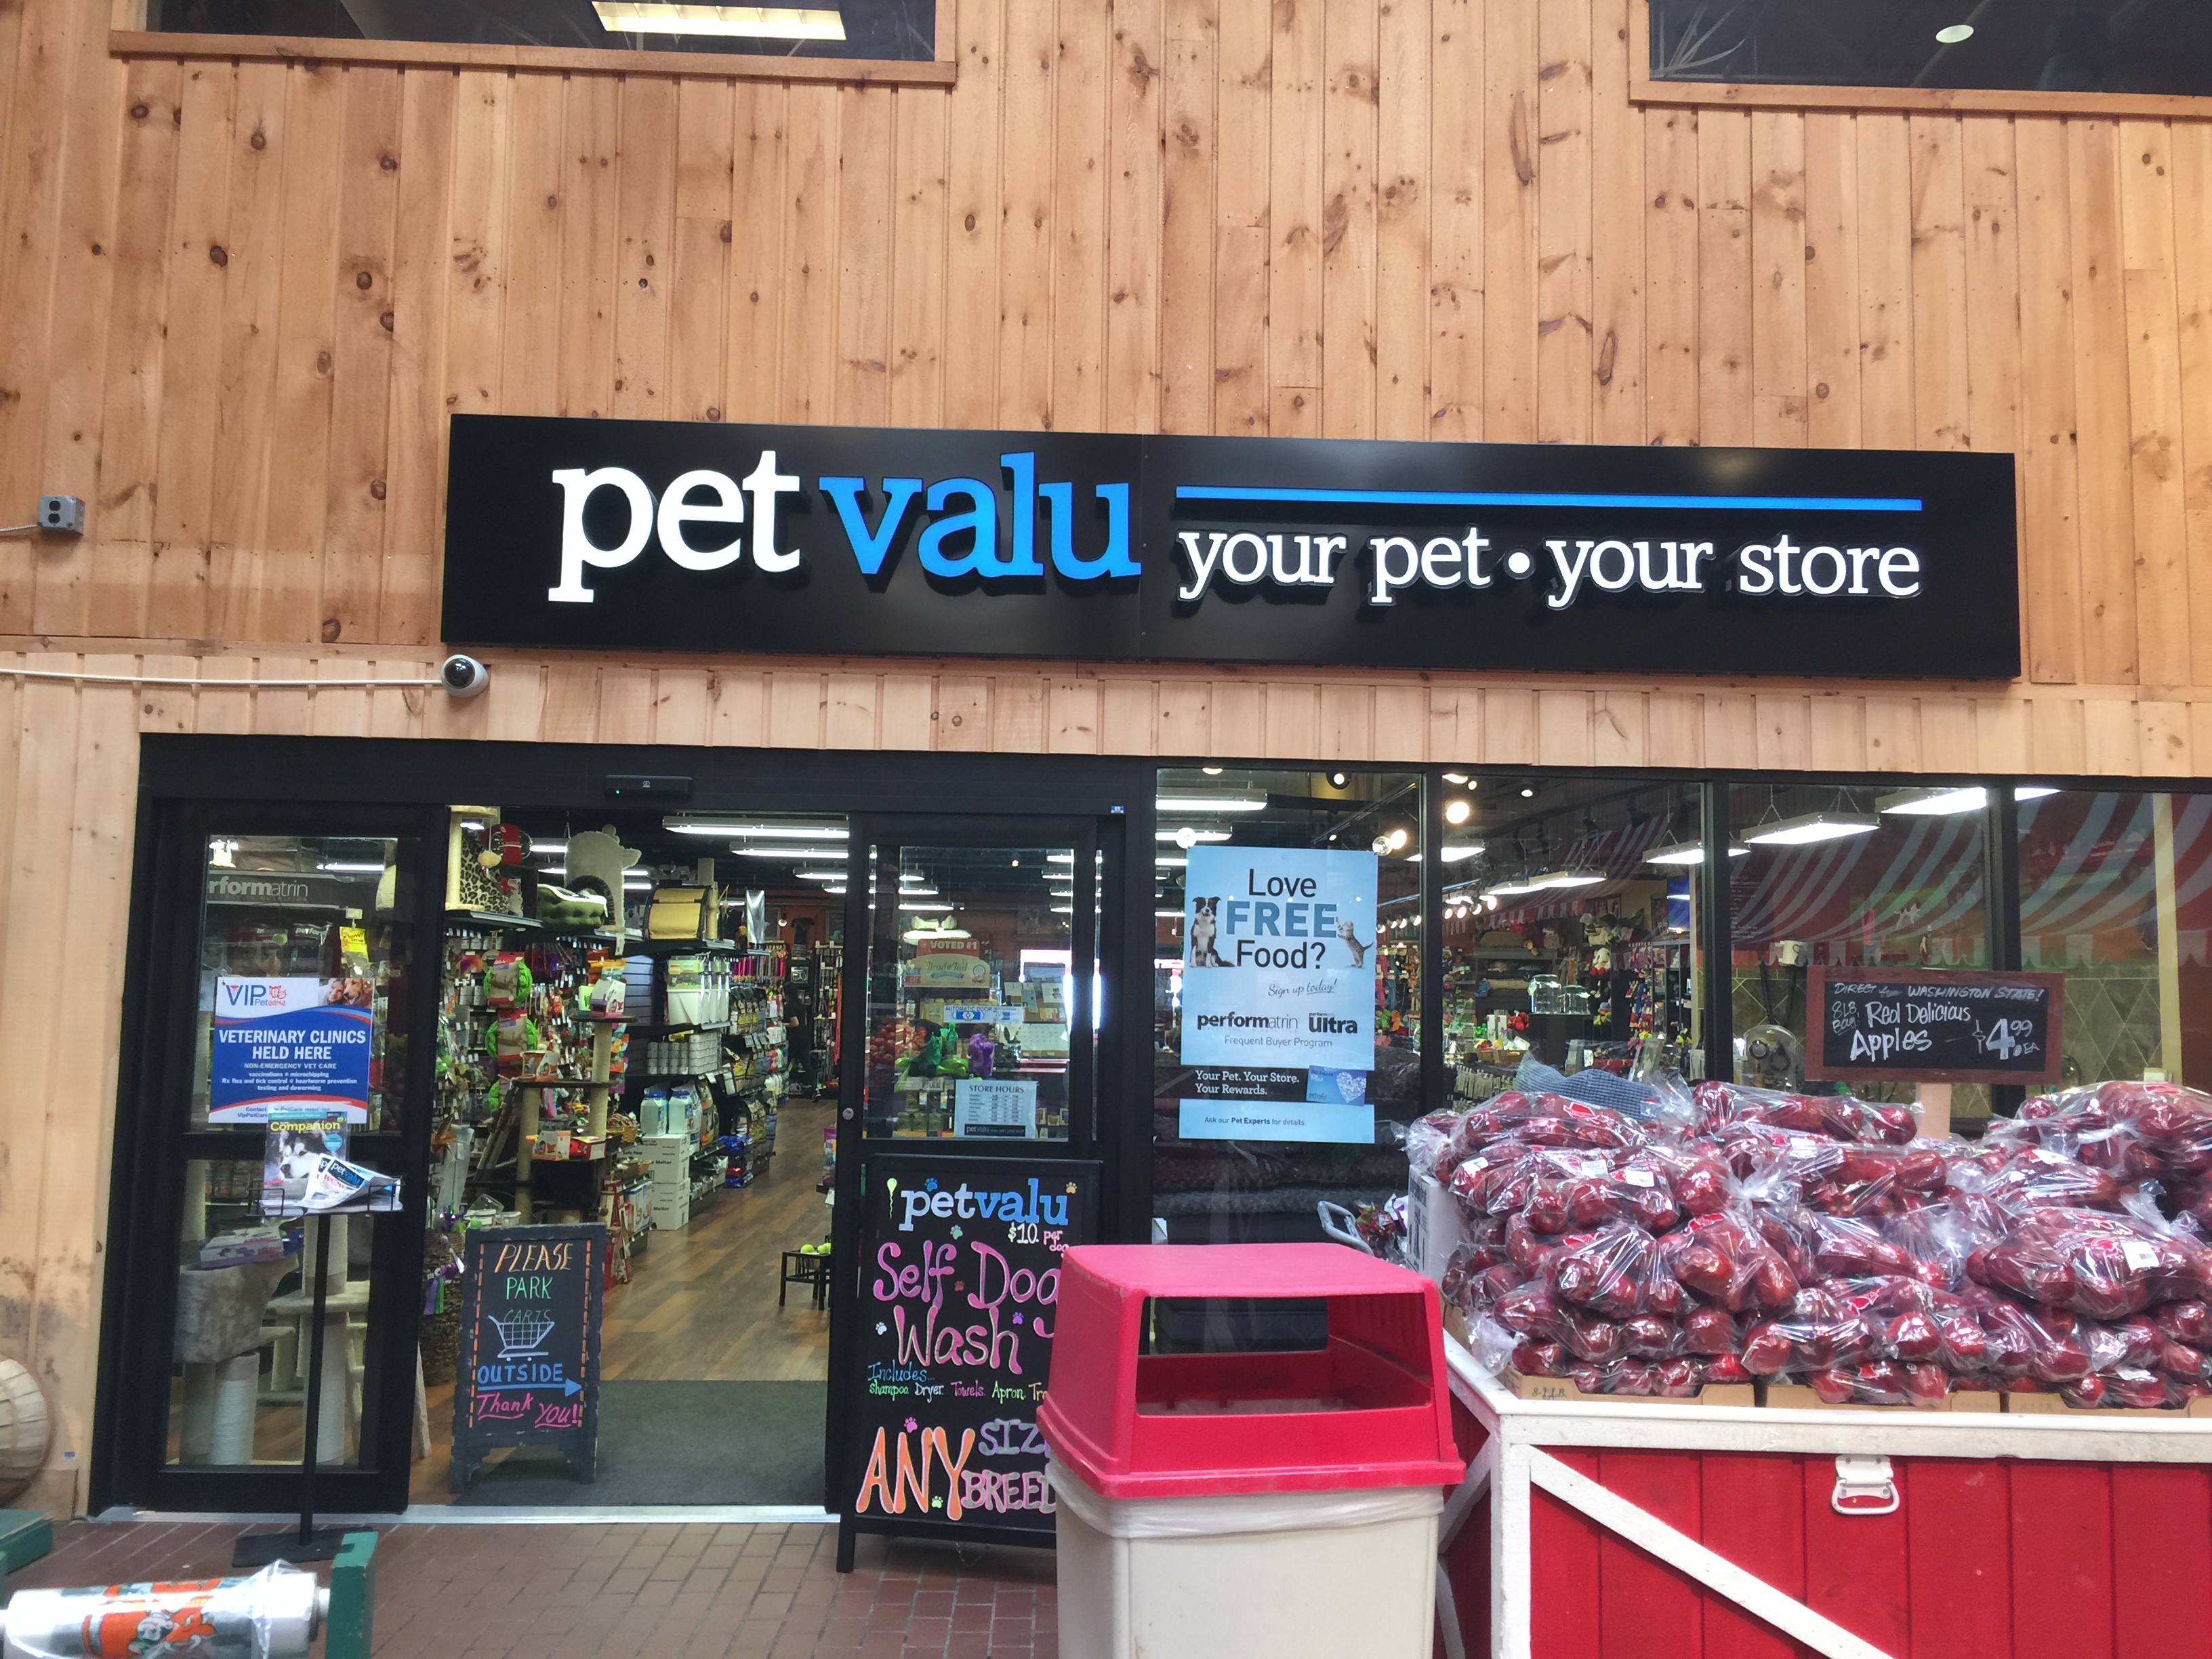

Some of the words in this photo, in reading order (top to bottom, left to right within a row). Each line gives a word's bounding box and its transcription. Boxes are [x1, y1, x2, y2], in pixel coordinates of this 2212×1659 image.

[548, 450, 800, 602] pet
[819, 451, 1141, 578] valu
[1178, 531, 1347, 600] your
[1370, 527, 1490, 603] pet
[1546, 539, 1713, 608] your
[1739, 533, 1921, 596] store
[209, 876, 309, 897] rformatrin
[1249, 869, 1316, 897] Love
[1226, 901, 1337, 938] FREE
[930, 941, 964, 949] VOTED
[1237, 940, 1326, 969] Food?
[226, 985, 266, 1006] VIP
[1268, 983, 1289, 997] Sign
[1292, 987, 1304, 996] up
[1307, 978, 1337, 995] today!
[1835, 983, 1877, 995] DIRECT
[1908, 985, 1991, 999] WASHINGTON
[1993, 986, 2043, 1002] STATE!
[1197, 1010, 1298, 1030] performatrin
[1309, 1017, 1357, 1033] ultra
[1865, 1001, 1901, 1029] Red
[1905, 1001, 1971, 1025] Delicious
[219, 1029, 306, 1044] VETERINARY
[310, 1030, 366, 1044] CLINICS
[1225, 1036, 1263, 1046] Frequent
[1266, 1037, 1291, 1048] Buyer
[1294, 1038, 1332, 1049] Program
[1849, 1027, 1932, 1062] Apples
[252, 1046, 289, 1060] HELD
[294, 1046, 332, 1060] HERE
[1195, 1070, 1220, 1081] Your
[1222, 1071, 1242, 1081] Pet.
[1244, 1071, 1267, 1082] Your
[1269, 1071, 1300, 1084] Store.
[969, 1084, 994, 1092] STORE
[1195, 1084, 1220, 1094] Your
[1222, 1084, 1268, 1095] Rewards.
[270, 1120, 341, 1134] Companion
[1244, 1117, 1271, 1126] Experts
[1283, 1118, 1307, 1126] details.
[331, 1162, 362, 1187] petvalu
[899, 1178, 1069, 1231] petvalu
[1042, 1230, 1063, 1246] per
[494, 1243, 573, 1273] PLEASE
[506, 1276, 553, 1300] PARK
[874, 1240, 957, 1309] Self
[967, 1240, 1062, 1338] Dog
[504, 1309, 552, 1324] CARTS
[893, 1305, 1023, 1374] Wash
[477, 1363, 563, 1385] OUTSIDE
[476, 1392, 534, 1416] Thank
[978, 1418, 1051, 1458] SIZ
[856, 1426, 976, 1521] ANY
